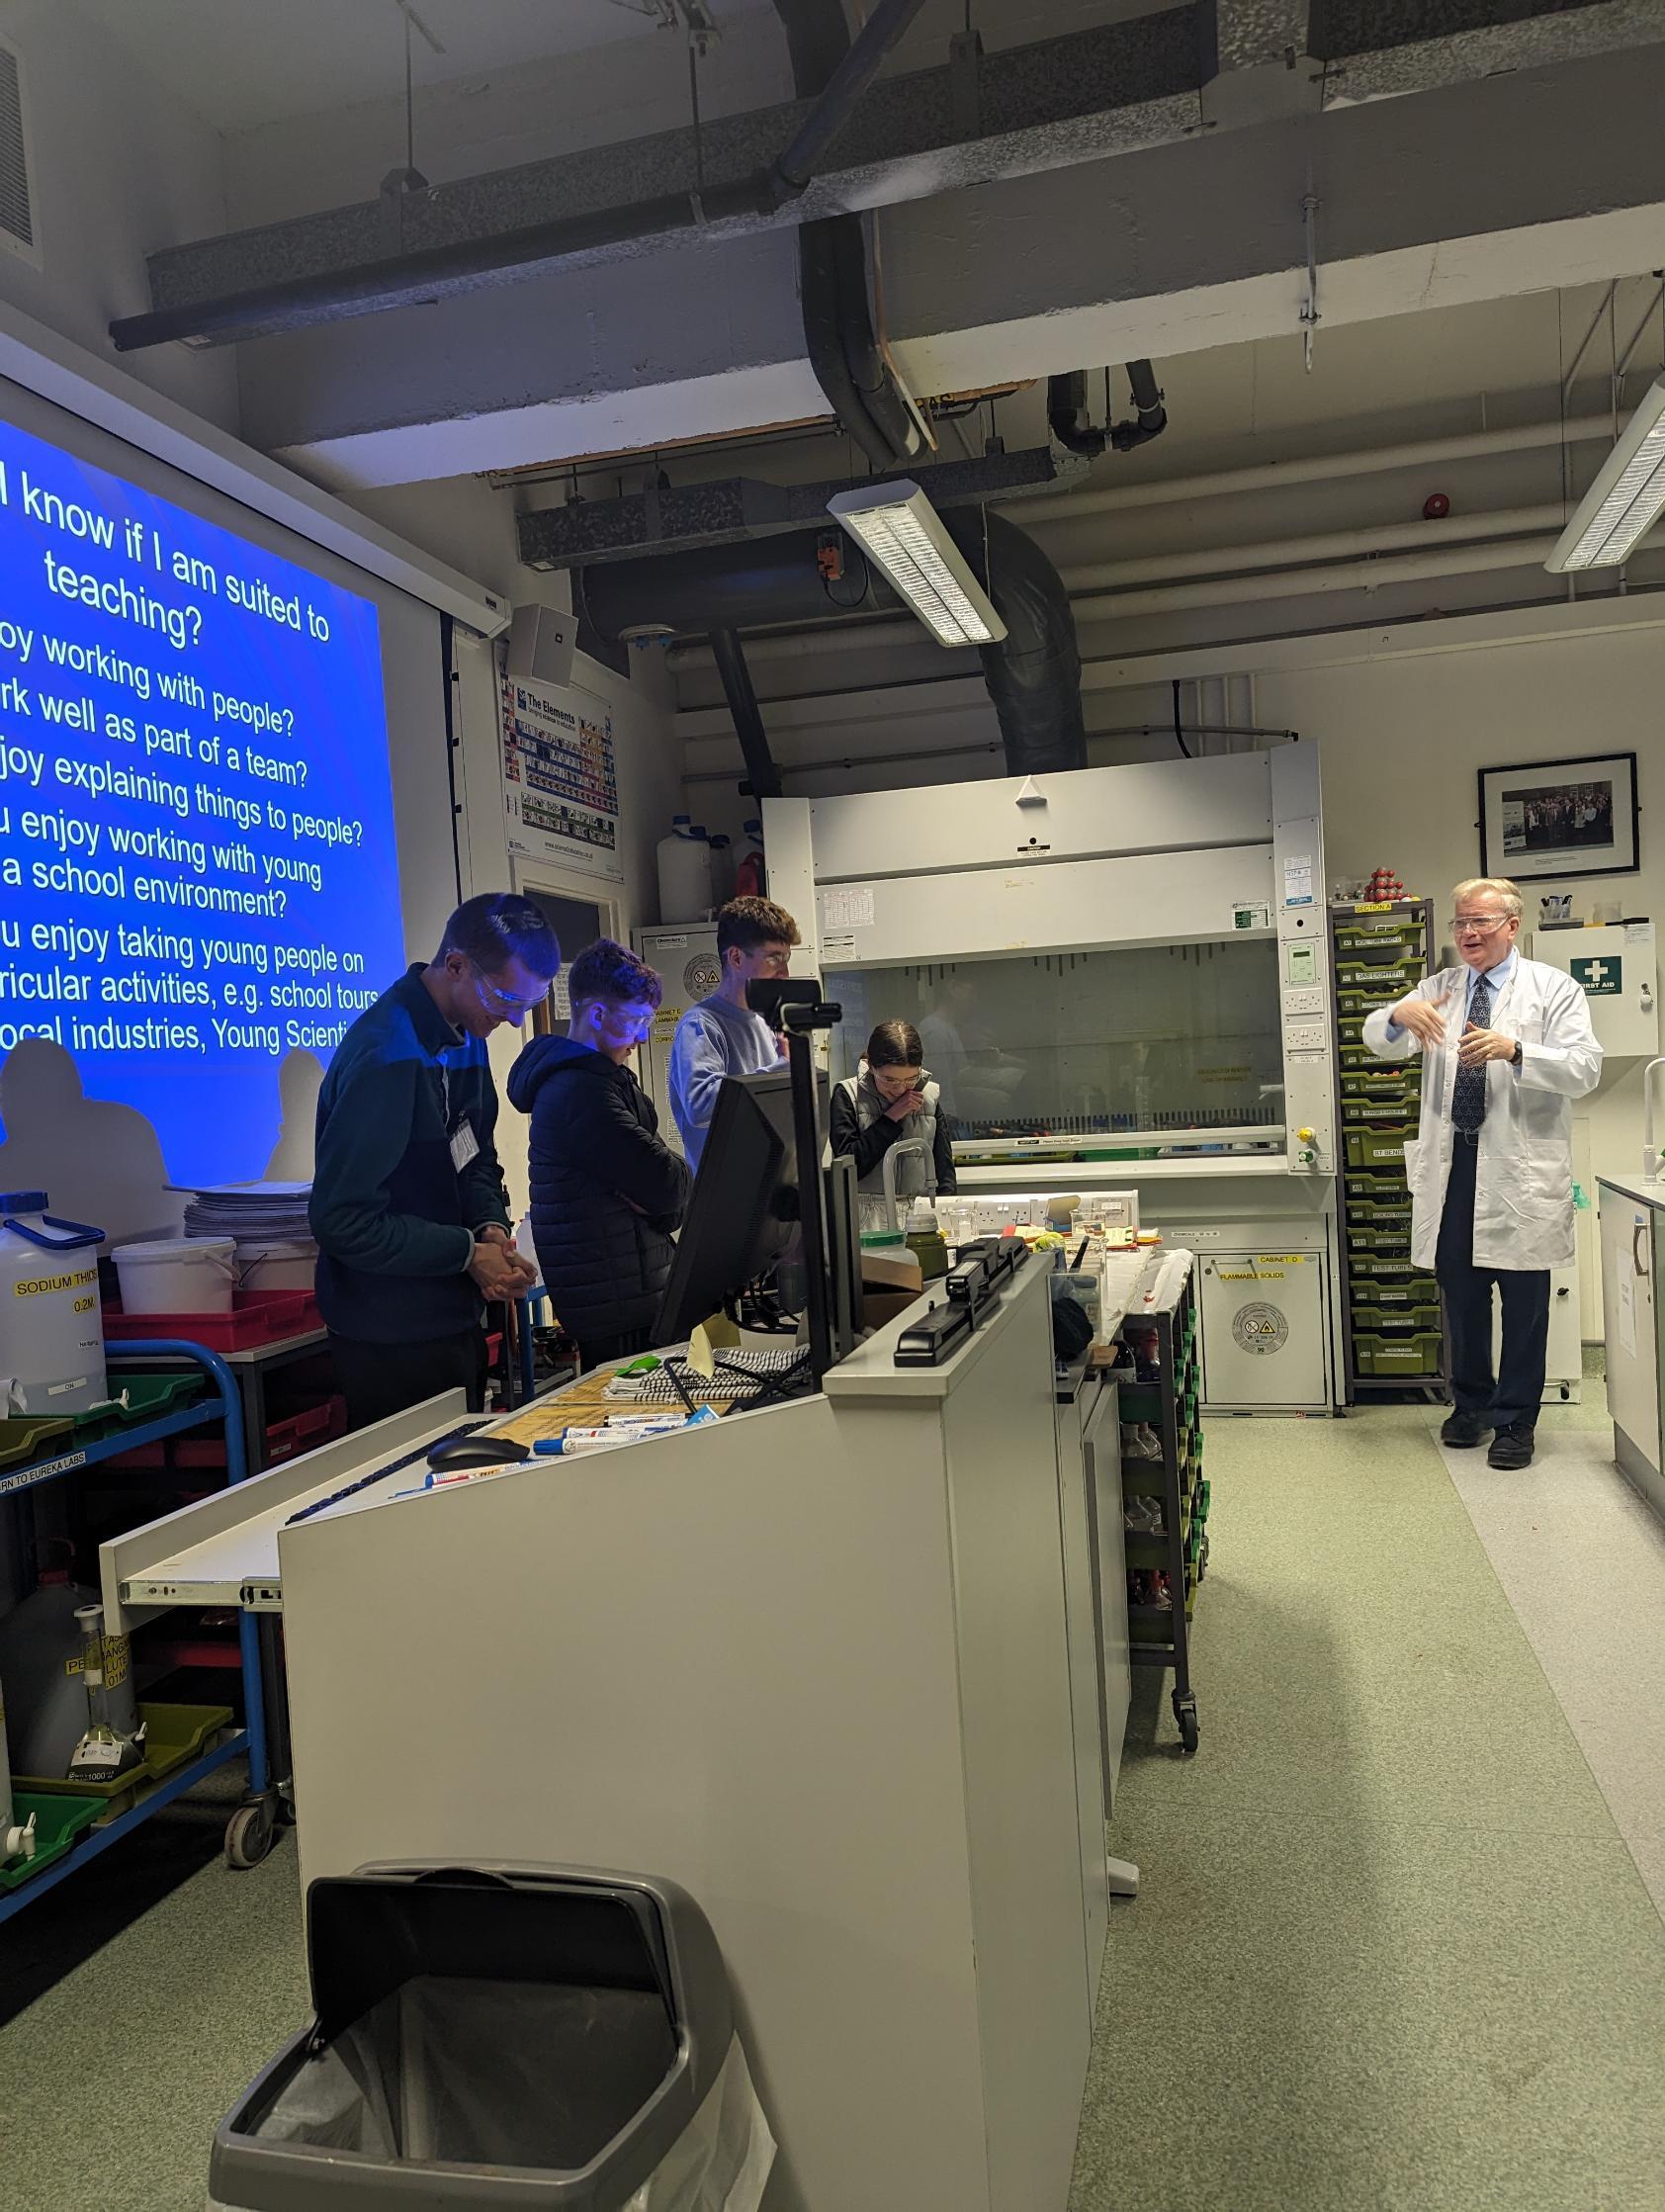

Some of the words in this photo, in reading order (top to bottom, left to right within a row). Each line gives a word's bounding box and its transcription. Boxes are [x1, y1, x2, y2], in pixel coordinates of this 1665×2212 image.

[22, 471, 115, 550] know
[125, 517, 143, 563] if
[153, 531, 162, 572] I
[172, 551, 218, 595] am
[225, 575, 302, 632] suited
[307, 603, 330, 643] to
[44, 550, 203, 650] teaching?
[43, 634, 150, 701] working
[157, 671, 206, 710] with
[213, 690, 295, 738] people?
[527, 692, 542, 710] The
[543, 699, 575, 725] Elements
[39, 692, 96, 733] well
[105, 712, 136, 743] as
[144, 724, 193, 758] part
[199, 736, 220, 765] of
[226, 748, 241, 771] a
[246, 746, 307, 788] team?
[54, 757, 189, 818] explaining
[195, 782, 262, 831] things
[267, 800, 287, 831] to
[293, 812, 363, 848] people?
[22, 808, 100, 857] enjoy
[108, 825, 207, 874] working
[212, 841, 256, 874] with
[262, 854, 322, 892] young
[3, 857, 22, 886] a
[33, 857, 126, 899] school
[134, 874, 287, 919] environment?
[1356, 904, 1384, 913] SECTION
[32, 918, 109, 963] enjoy
[118, 923, 194, 969] taking
[201, 938, 268, 974] young
[274, 943, 338, 977] people
[343, 952, 364, 974] on
[101, 970, 217, 1011] activities,
[223, 981, 265, 1015] e.g.
[270, 979, 332, 1009] school
[72, 1015, 207, 1055] industries,
[212, 1018, 281, 1056] Young
[17, 1276, 72, 1295] SODIUM
[16, 1473, 28, 1483] TO
[30, 1461, 63, 1481] EUREKA
[64, 1453, 84, 1468] LABS
